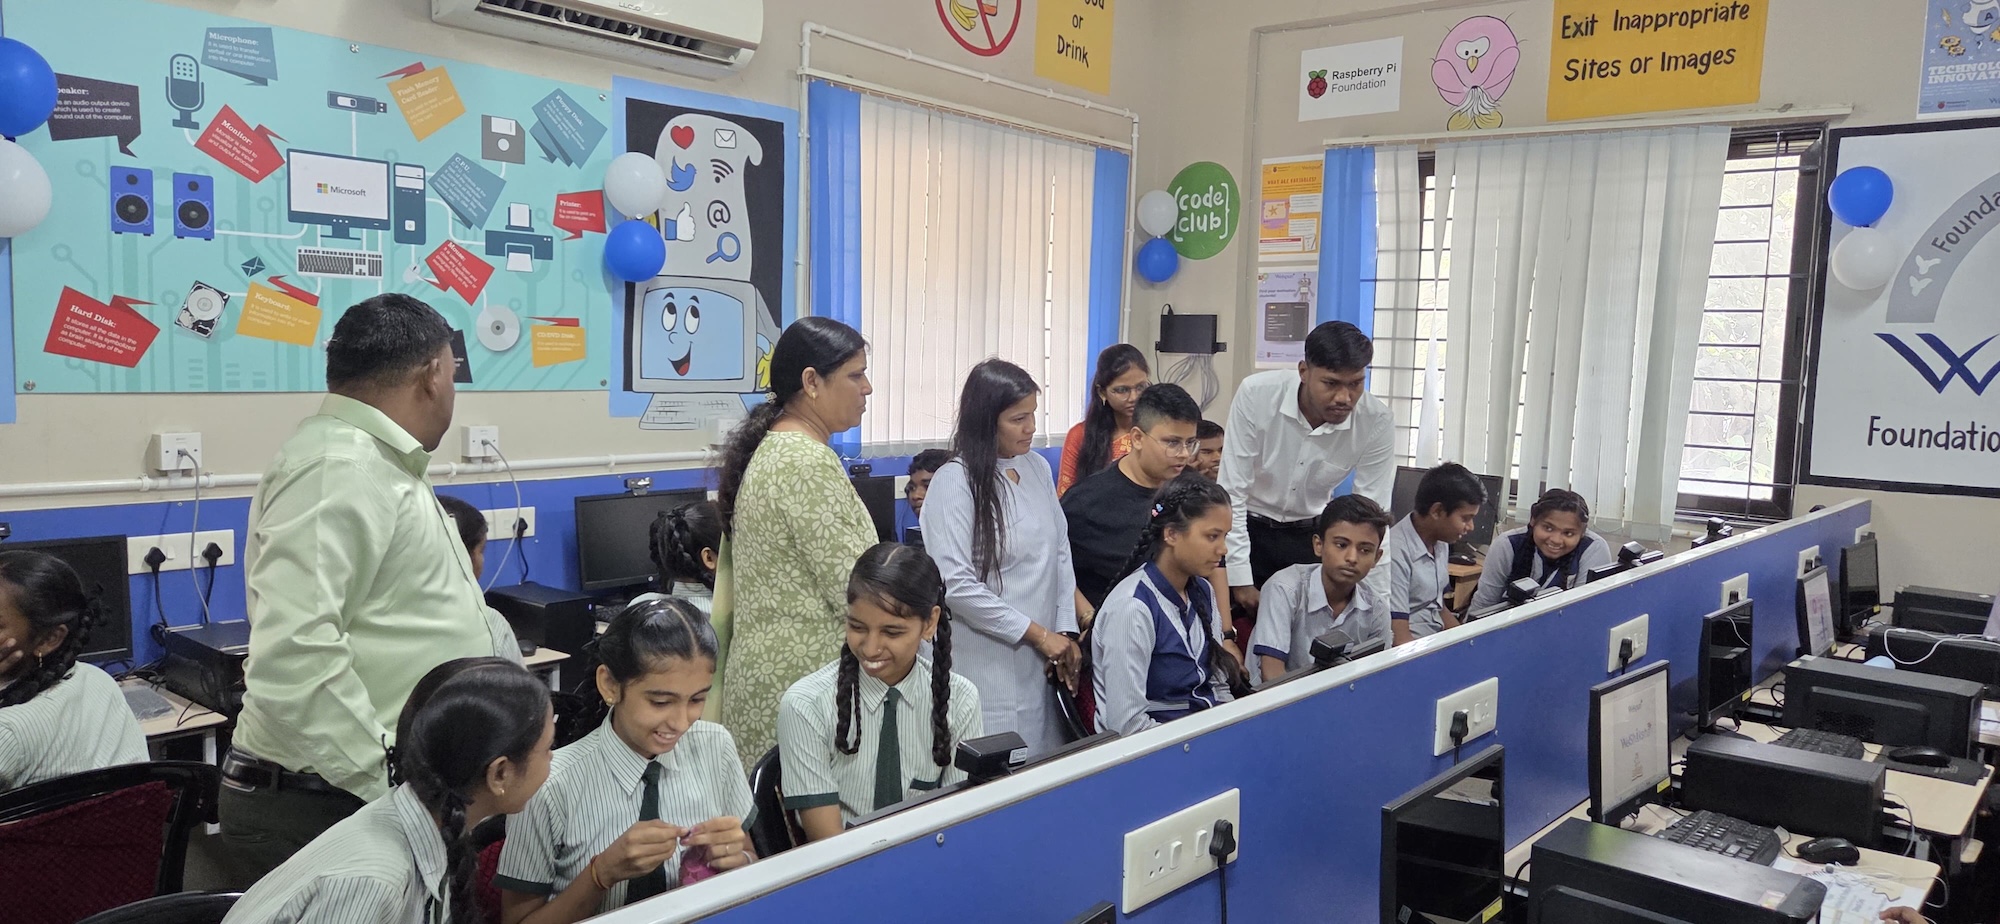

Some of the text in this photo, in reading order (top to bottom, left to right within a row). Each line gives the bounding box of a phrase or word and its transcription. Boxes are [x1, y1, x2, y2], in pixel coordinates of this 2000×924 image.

[1072, 14, 1084, 29] or
[1561, 0, 1750, 40] Exit Inappropriate
[209, 31, 258, 45] Microphone:
[1057, 34, 1090, 68] Drink
[1332, 63, 1397, 80] Raspberry Pi
[1564, 48, 1736, 82] Sites or Images
[57, 87, 89, 95] peaker:
[1332, 79, 1386, 93] Foundation
[221, 119, 252, 145] Monitor:
[330, 186, 366, 196] Microsoft
[1179, 185, 1224, 210] code
[1178, 212, 1221, 232] club
[447, 241, 465, 261] Mouse:
[254, 292, 290, 311] Keyboard:
[70, 304, 116, 328] Hard Disk:
[70, 318, 89, 328] stores
[107, 331, 120, 339] data
[127, 337, 137, 345] the
[1867, 416, 2000, 452] Foundatio
